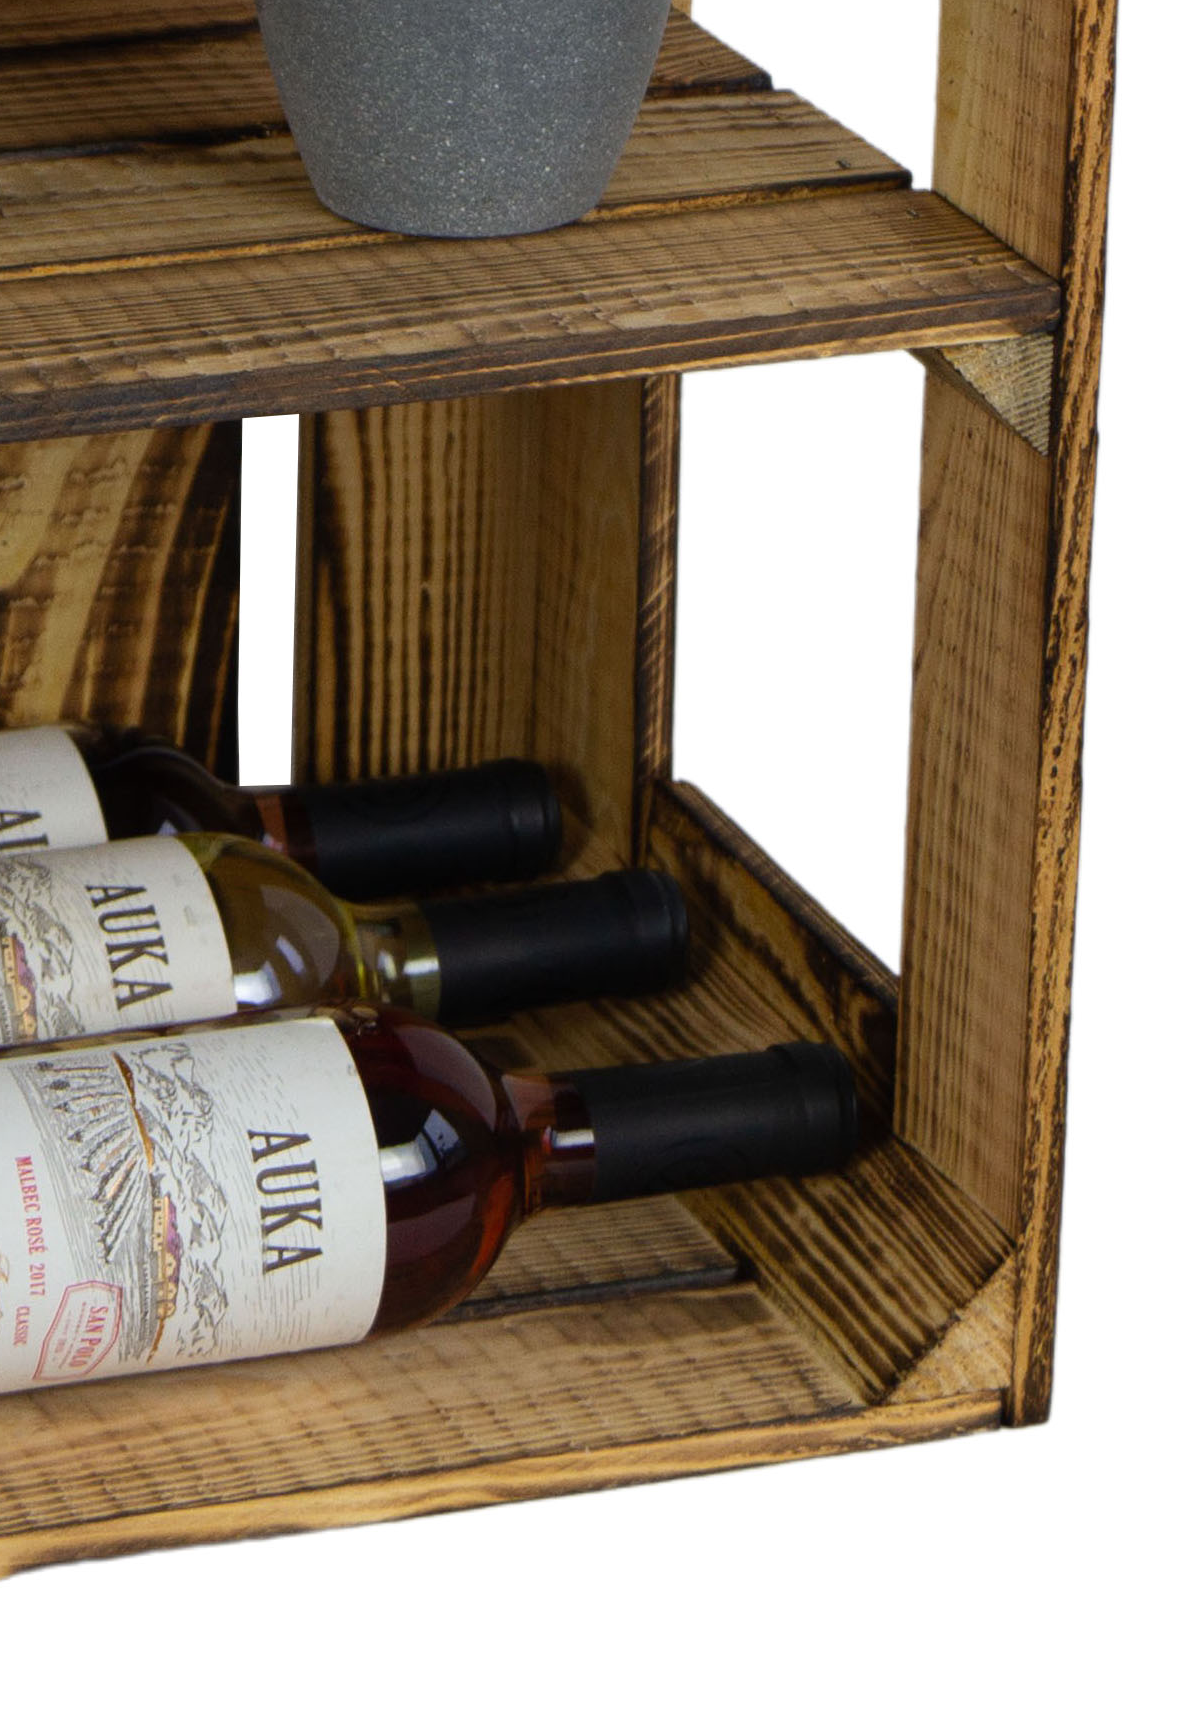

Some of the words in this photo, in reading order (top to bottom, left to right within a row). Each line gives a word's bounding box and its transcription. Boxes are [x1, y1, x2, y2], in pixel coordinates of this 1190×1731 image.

[85, 884, 173, 1010] AUKA
[15, 1155, 40, 1213] MALBEC
[29, 1263, 46, 1297] 2017
[247, 1129, 324, 1276] AUKA
[13, 1305, 31, 1347] CLASSIC
[84, 1305, 109, 1334] SAN
